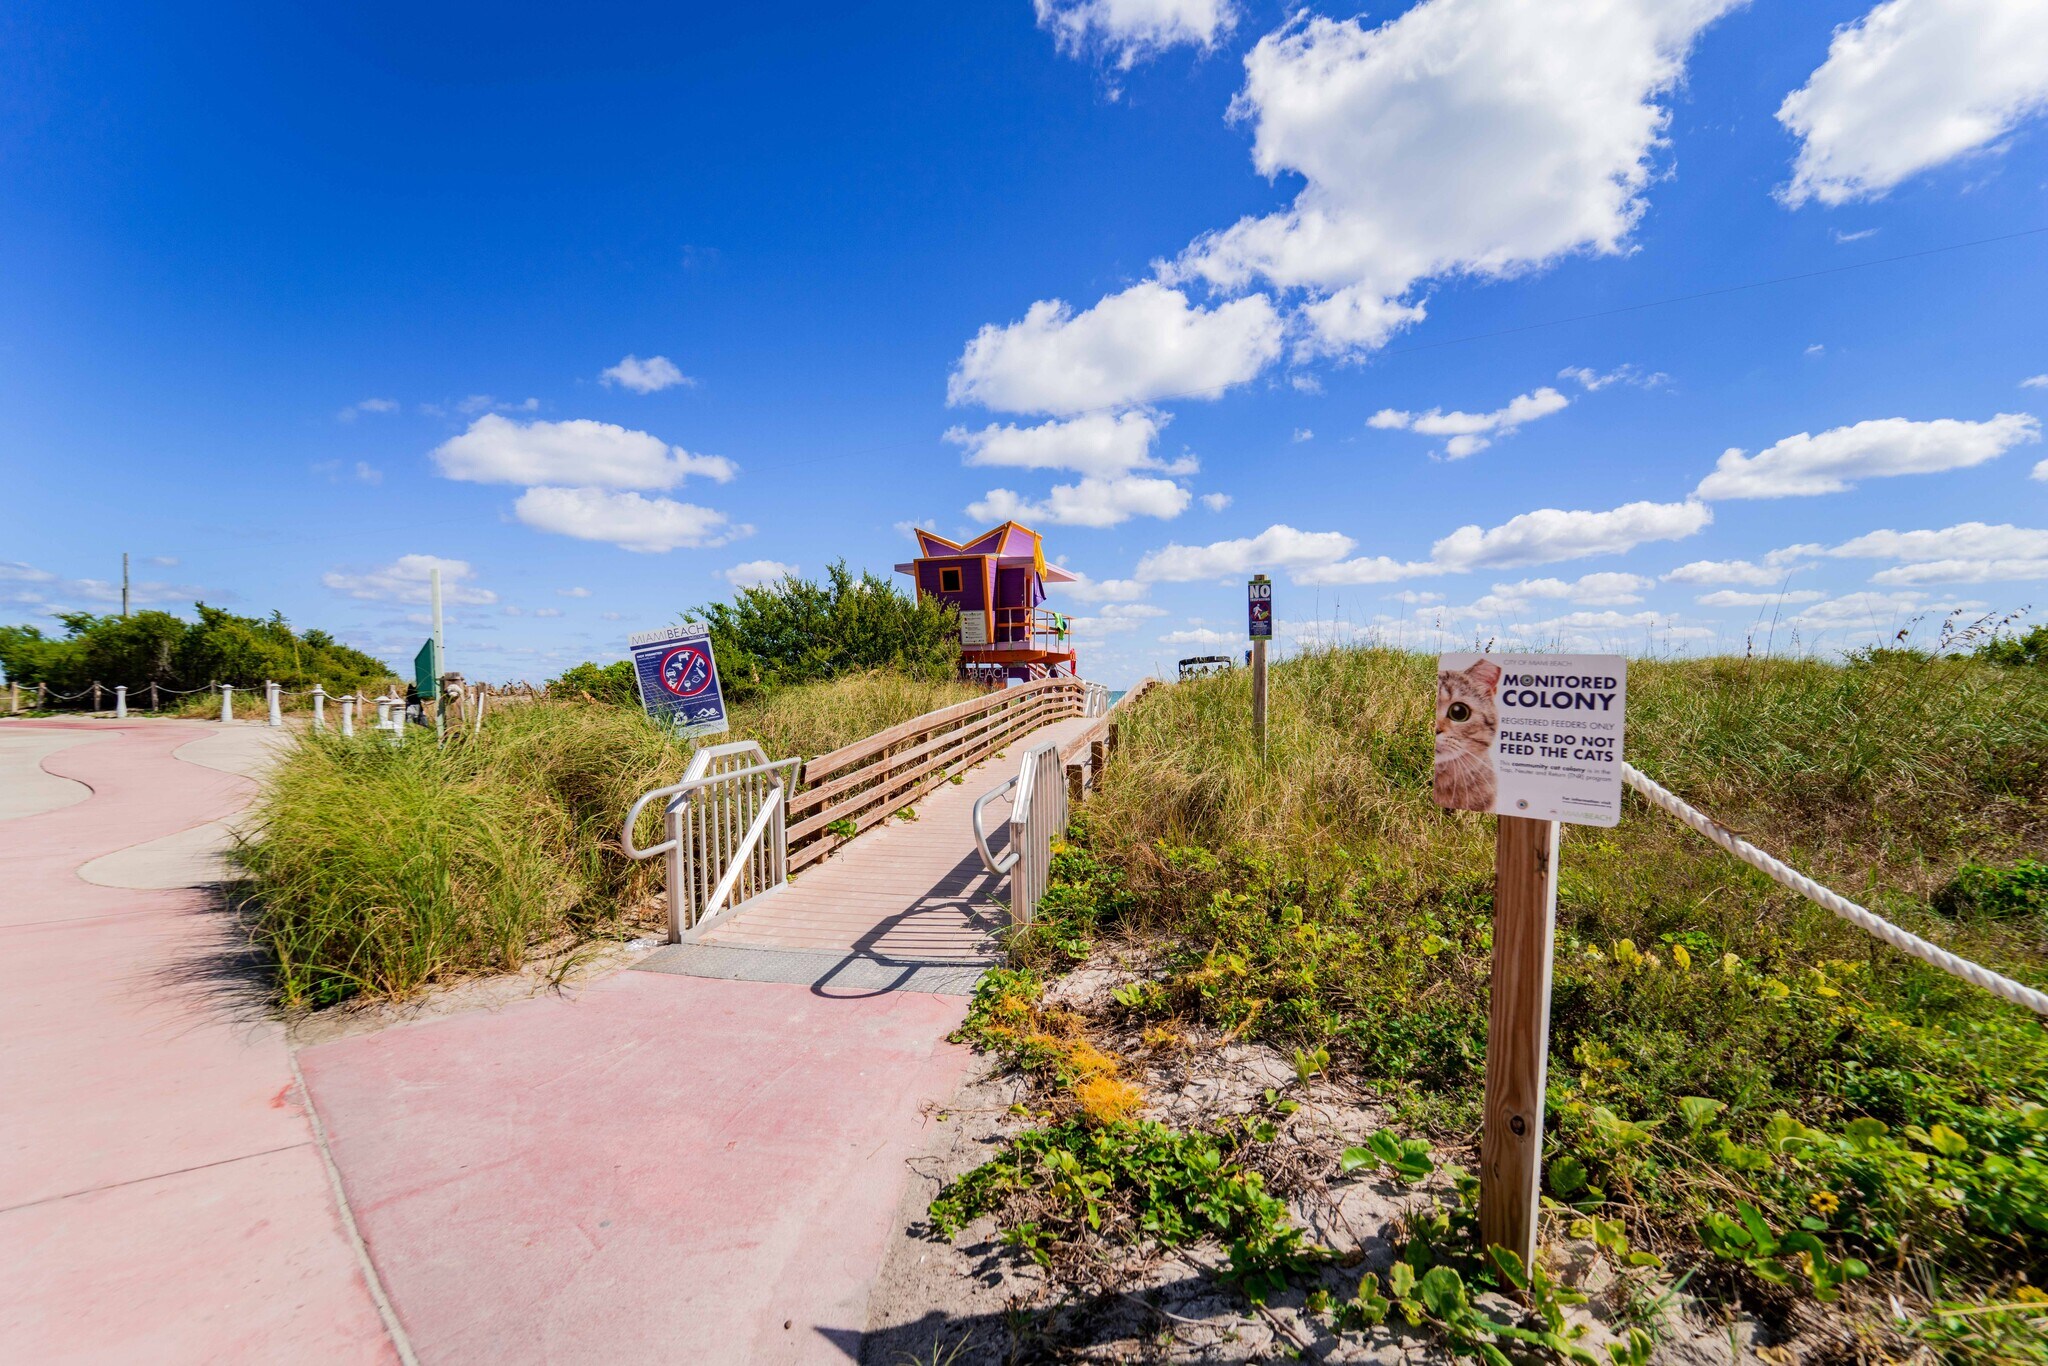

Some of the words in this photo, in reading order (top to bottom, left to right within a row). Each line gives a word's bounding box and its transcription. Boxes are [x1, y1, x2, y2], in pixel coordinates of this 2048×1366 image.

[1249, 585, 1270, 598] NO
[1503, 674, 1617, 689] MONITORED
[1502, 689, 1616, 711] COLONY
[1501, 717, 1549, 727] REGISTERED
[1551, 719, 1587, 729] FEEDERS
[1589, 722, 1615, 731] ONLY
[1500, 730, 1549, 743] PLEASE
[1553, 734, 1576, 746] DO
[1581, 736, 1615, 748] NOT
[1500, 743, 1534, 756] FEED
[1539, 746, 1568, 759] THE
[1573, 748, 1613, 762] CATS
[1511, 761, 1548, 770] community
[1562, 765, 1586, 774] colony
[1585, 774, 1612, 783] program
